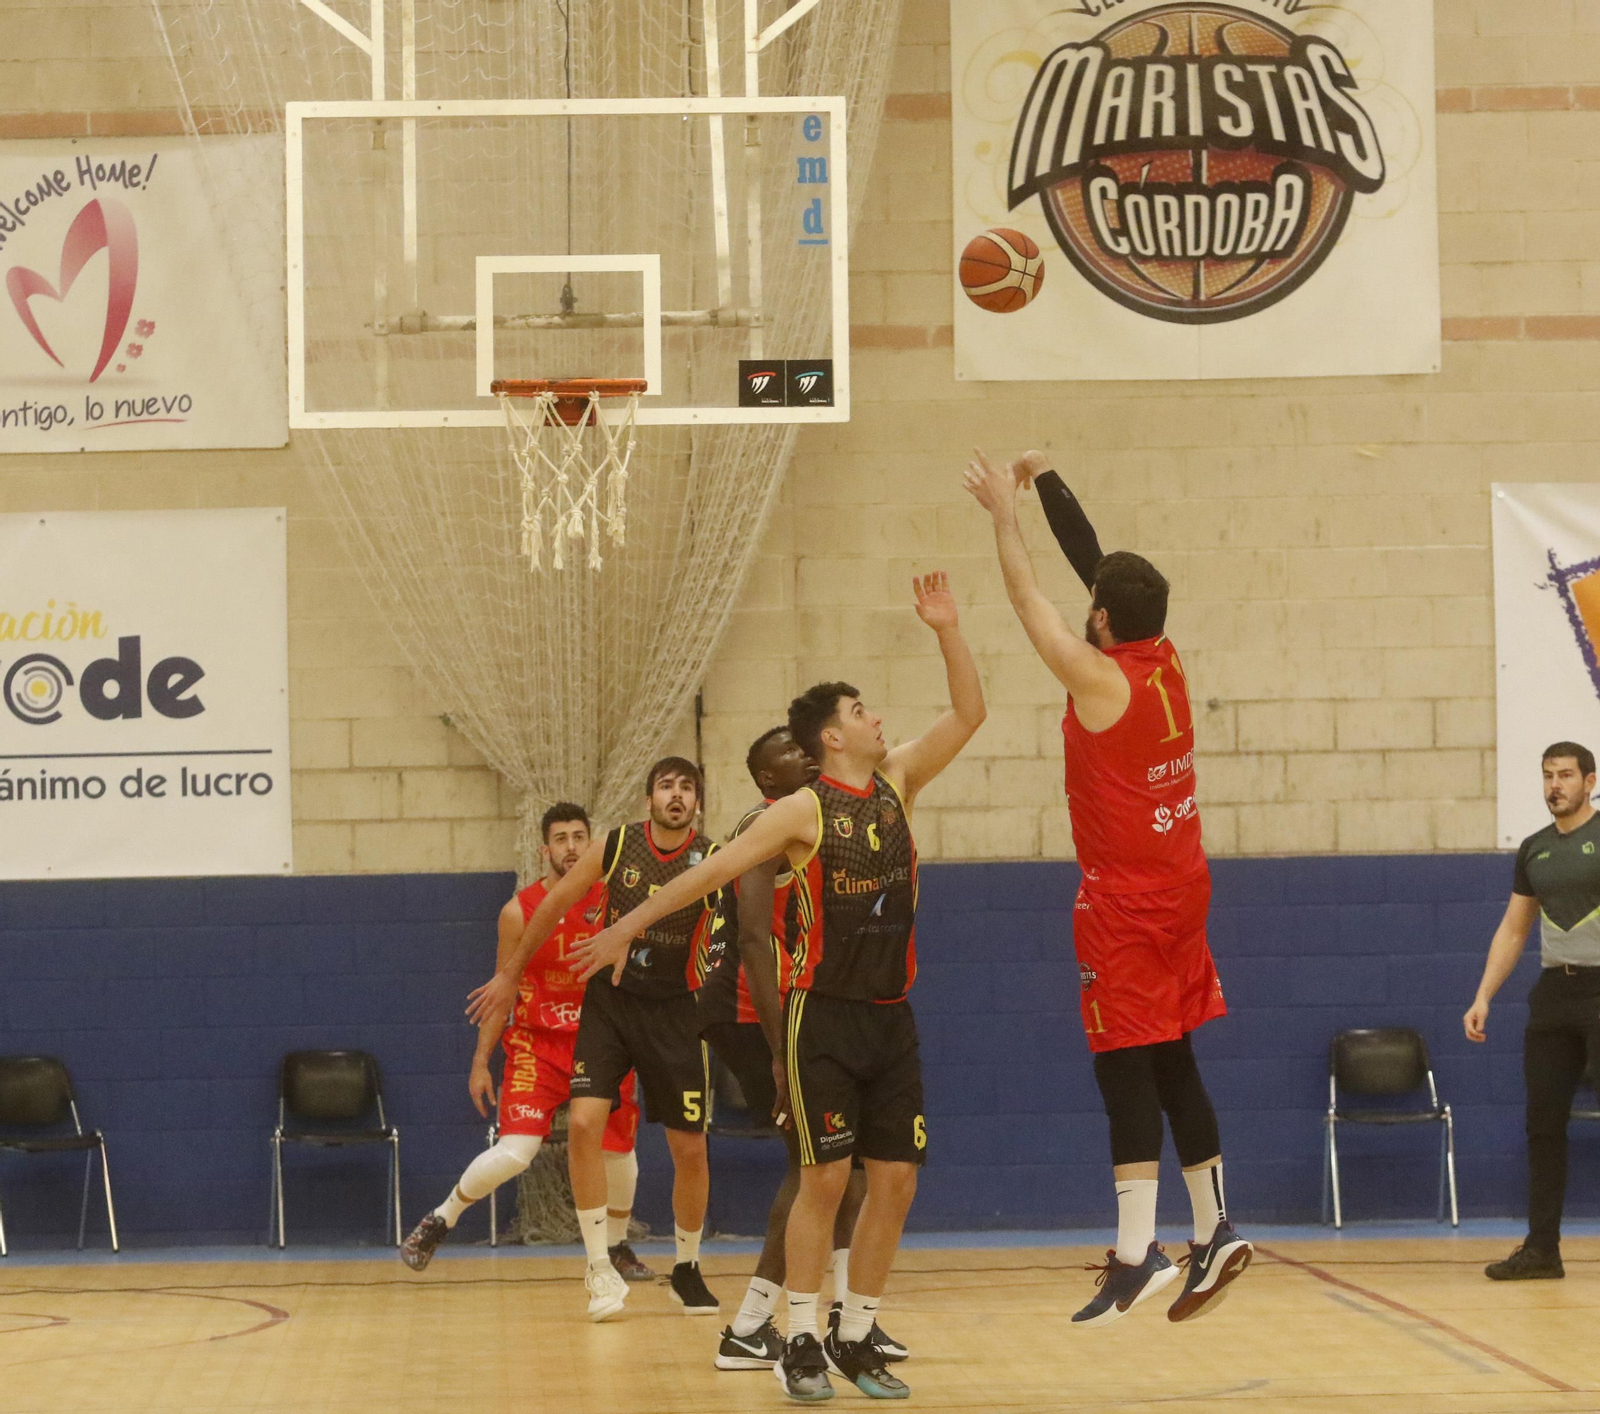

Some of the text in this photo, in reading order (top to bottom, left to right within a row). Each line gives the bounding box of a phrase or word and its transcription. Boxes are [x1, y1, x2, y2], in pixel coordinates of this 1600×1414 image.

[1010, 42, 1384, 193] MARISTAS
[1, 394, 193, 431] ntigo, lo nuevo
[0, 766, 273, 801] ánimo de lucro
[682, 1090, 702, 1122] 5
[913, 1114, 927, 1151] 6
